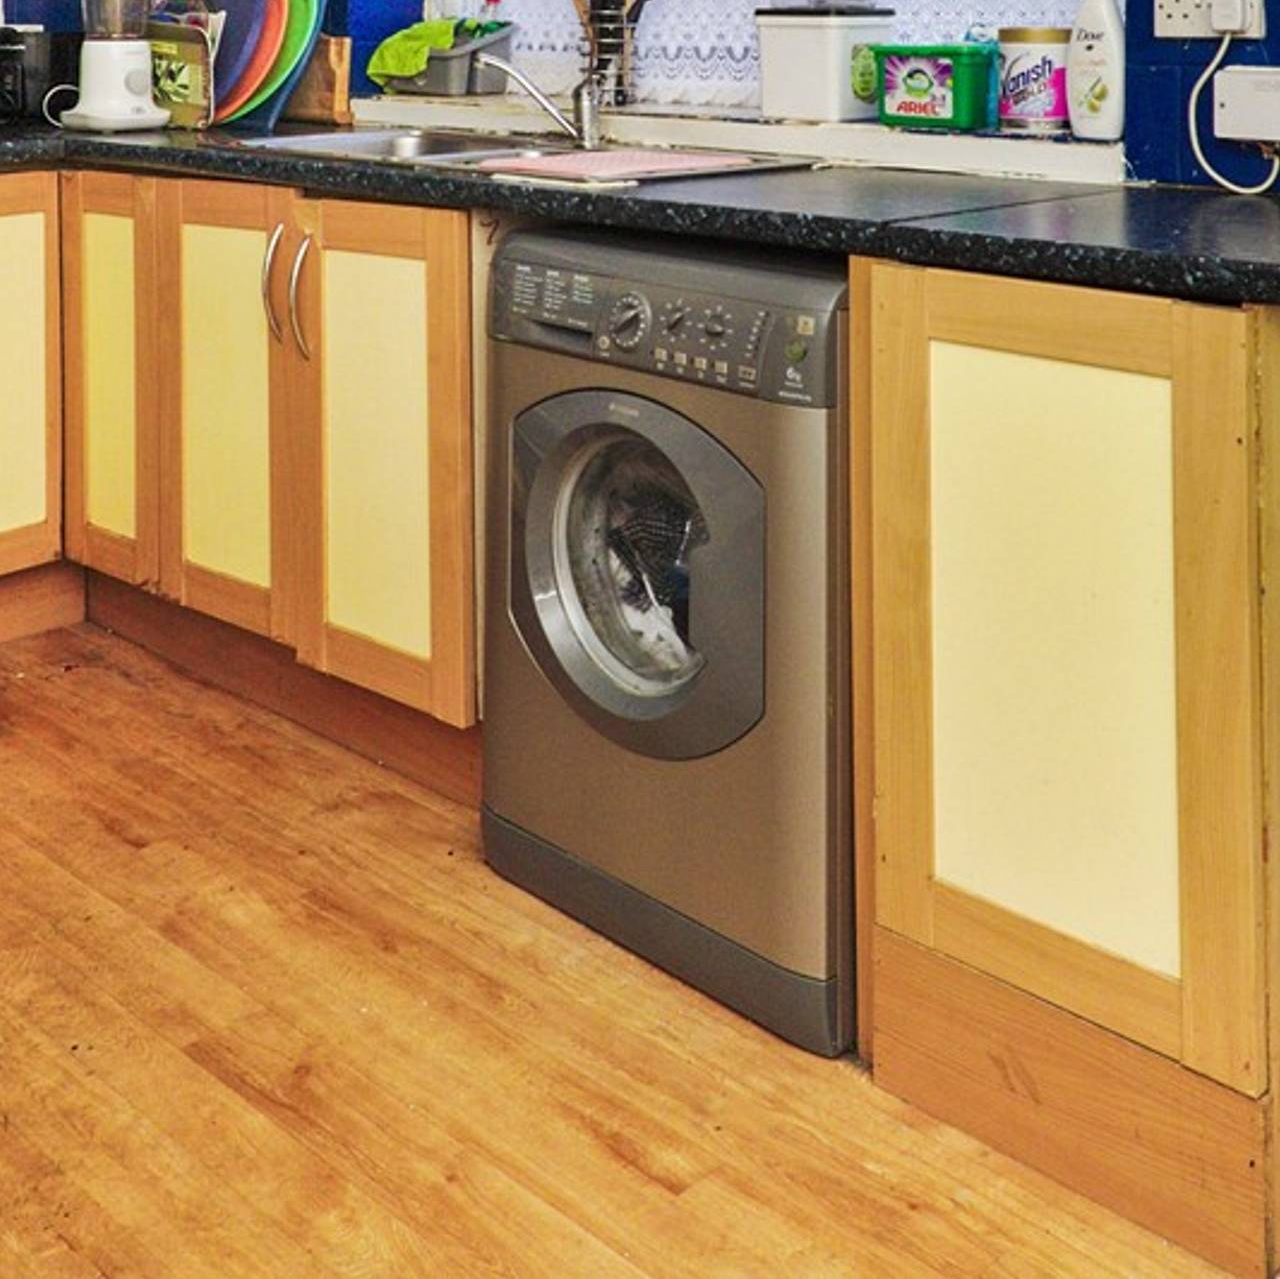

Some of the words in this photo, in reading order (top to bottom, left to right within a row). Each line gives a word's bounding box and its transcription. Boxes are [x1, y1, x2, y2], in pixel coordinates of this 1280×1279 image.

[1076, 28, 1104, 42] Dove
[1000, 52, 1053, 99] Vanish
[896, 101, 939, 115] ARIEL
